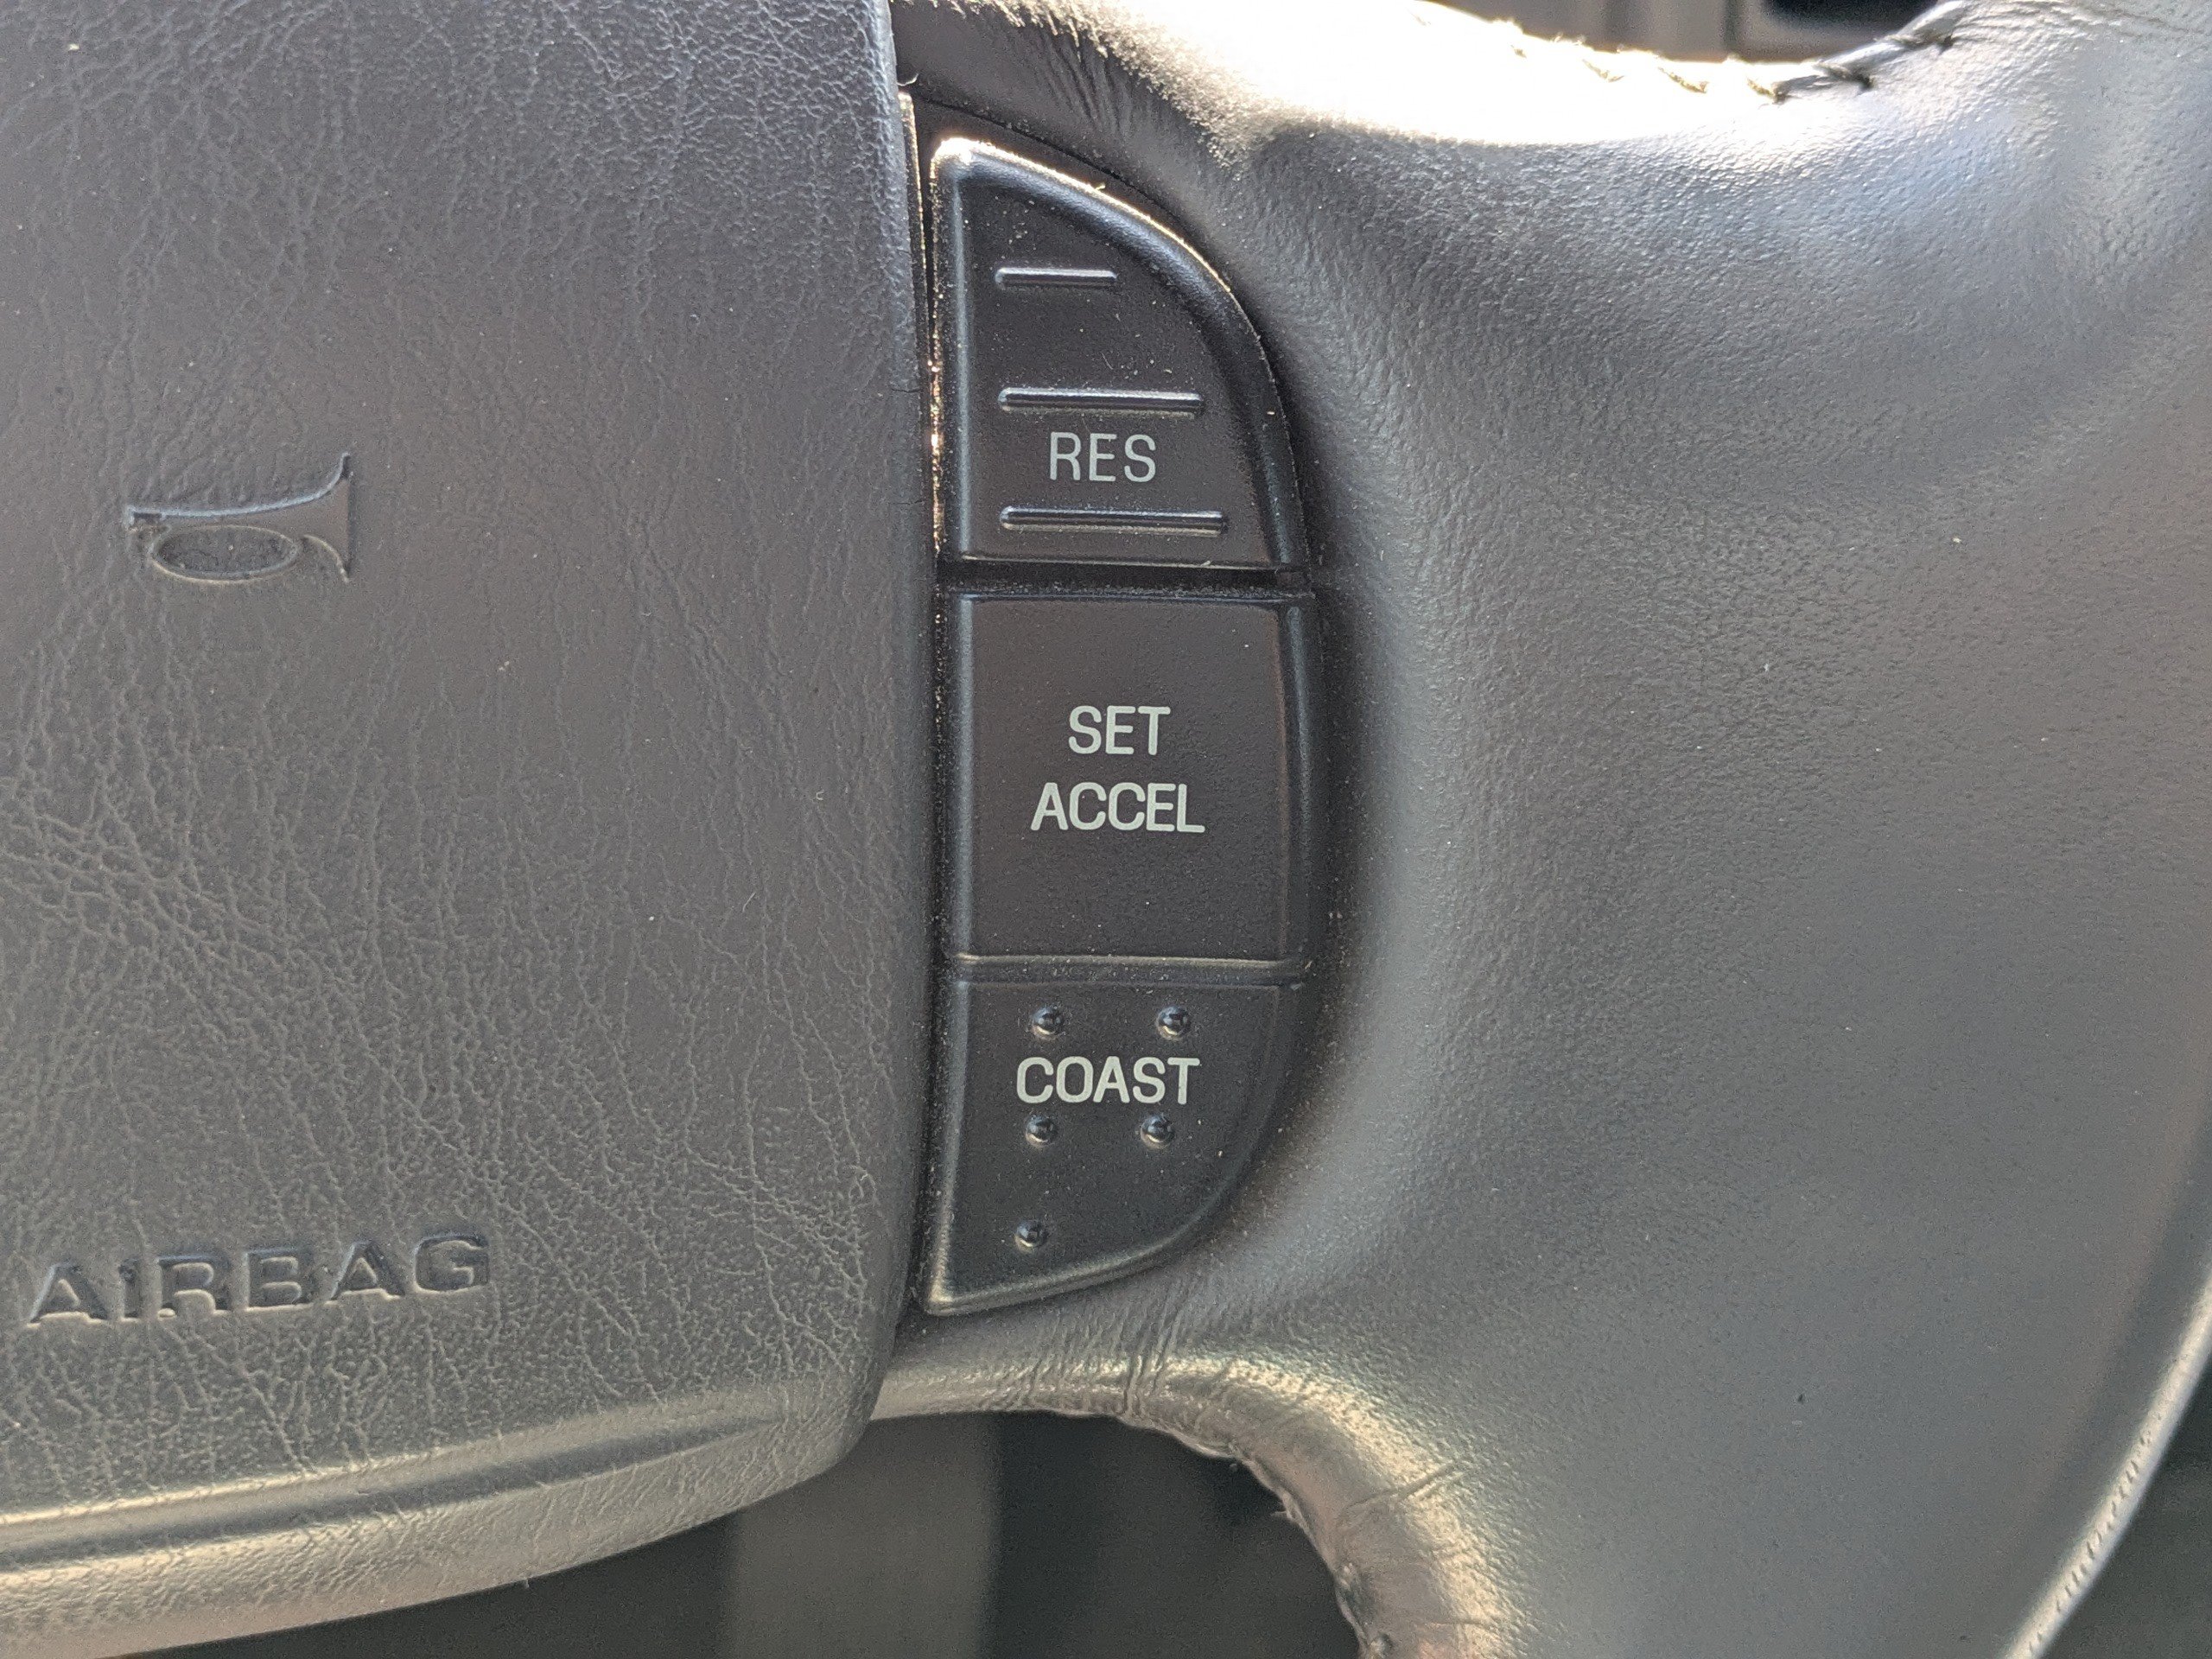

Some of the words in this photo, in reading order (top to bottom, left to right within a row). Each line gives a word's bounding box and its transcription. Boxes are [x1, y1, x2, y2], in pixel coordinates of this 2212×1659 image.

[1049, 431, 1157, 483] RES
[1068, 705, 1171, 755] SET
[1031, 781, 1205, 833] ACCEL
[1015, 1056, 1201, 1105] COAST
[26, 1233, 490, 1329] AIRBAG
